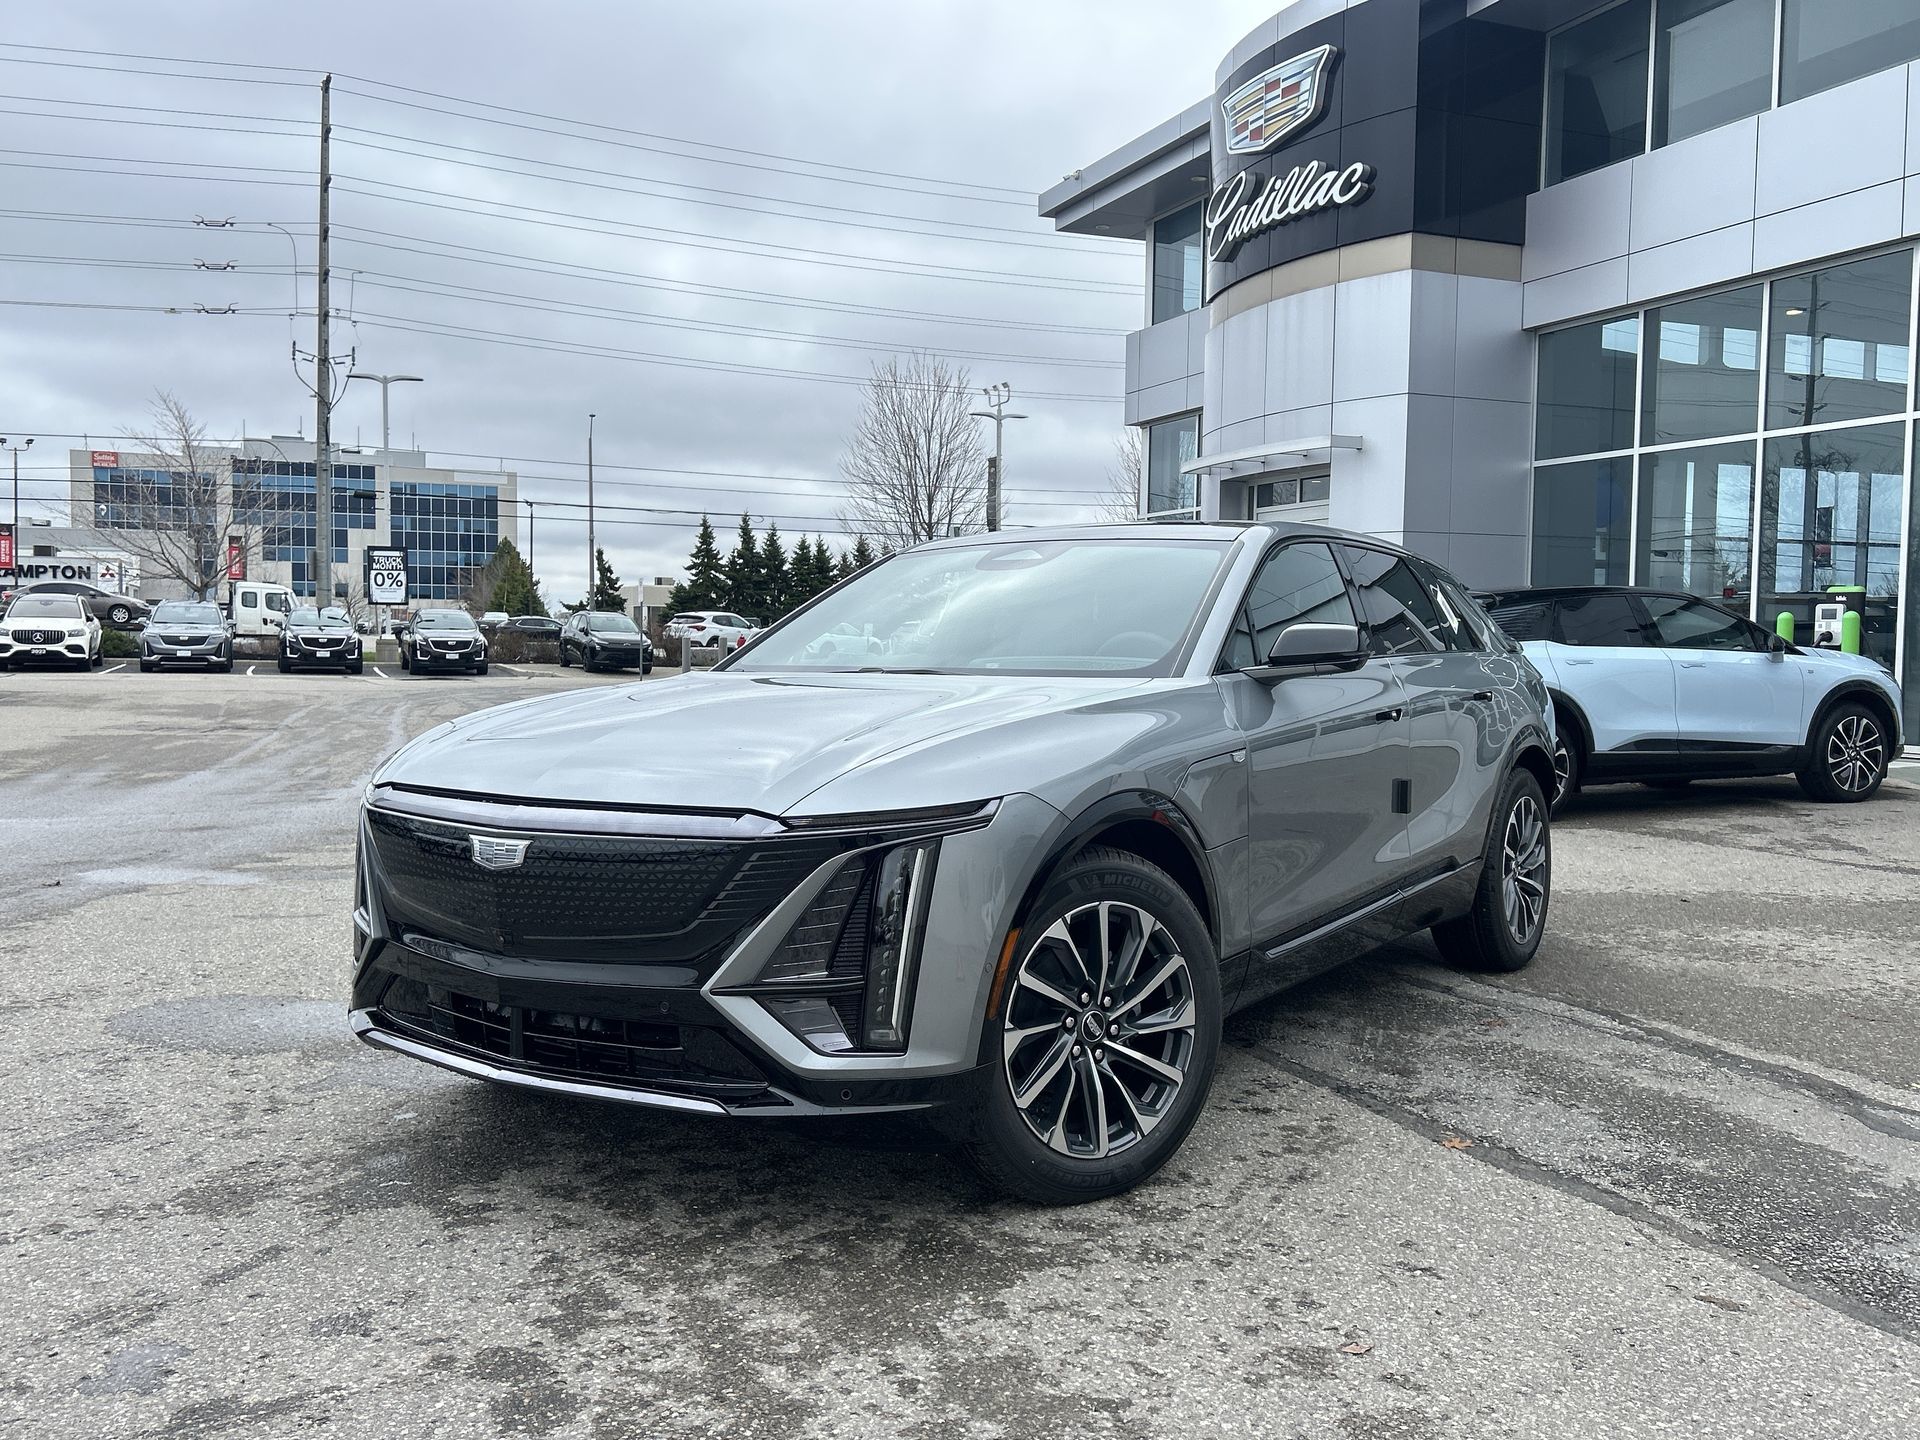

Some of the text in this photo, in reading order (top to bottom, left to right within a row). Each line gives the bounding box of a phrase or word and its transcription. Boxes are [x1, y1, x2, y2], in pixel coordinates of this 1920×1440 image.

[1206, 160, 1364, 261] Cadillac
[372, 562, 404, 570] MONTH
[373, 556, 402, 564] TRUCK
[373, 572, 404, 588] 0%
[1103, 873, 1174, 902] MICHELIN
